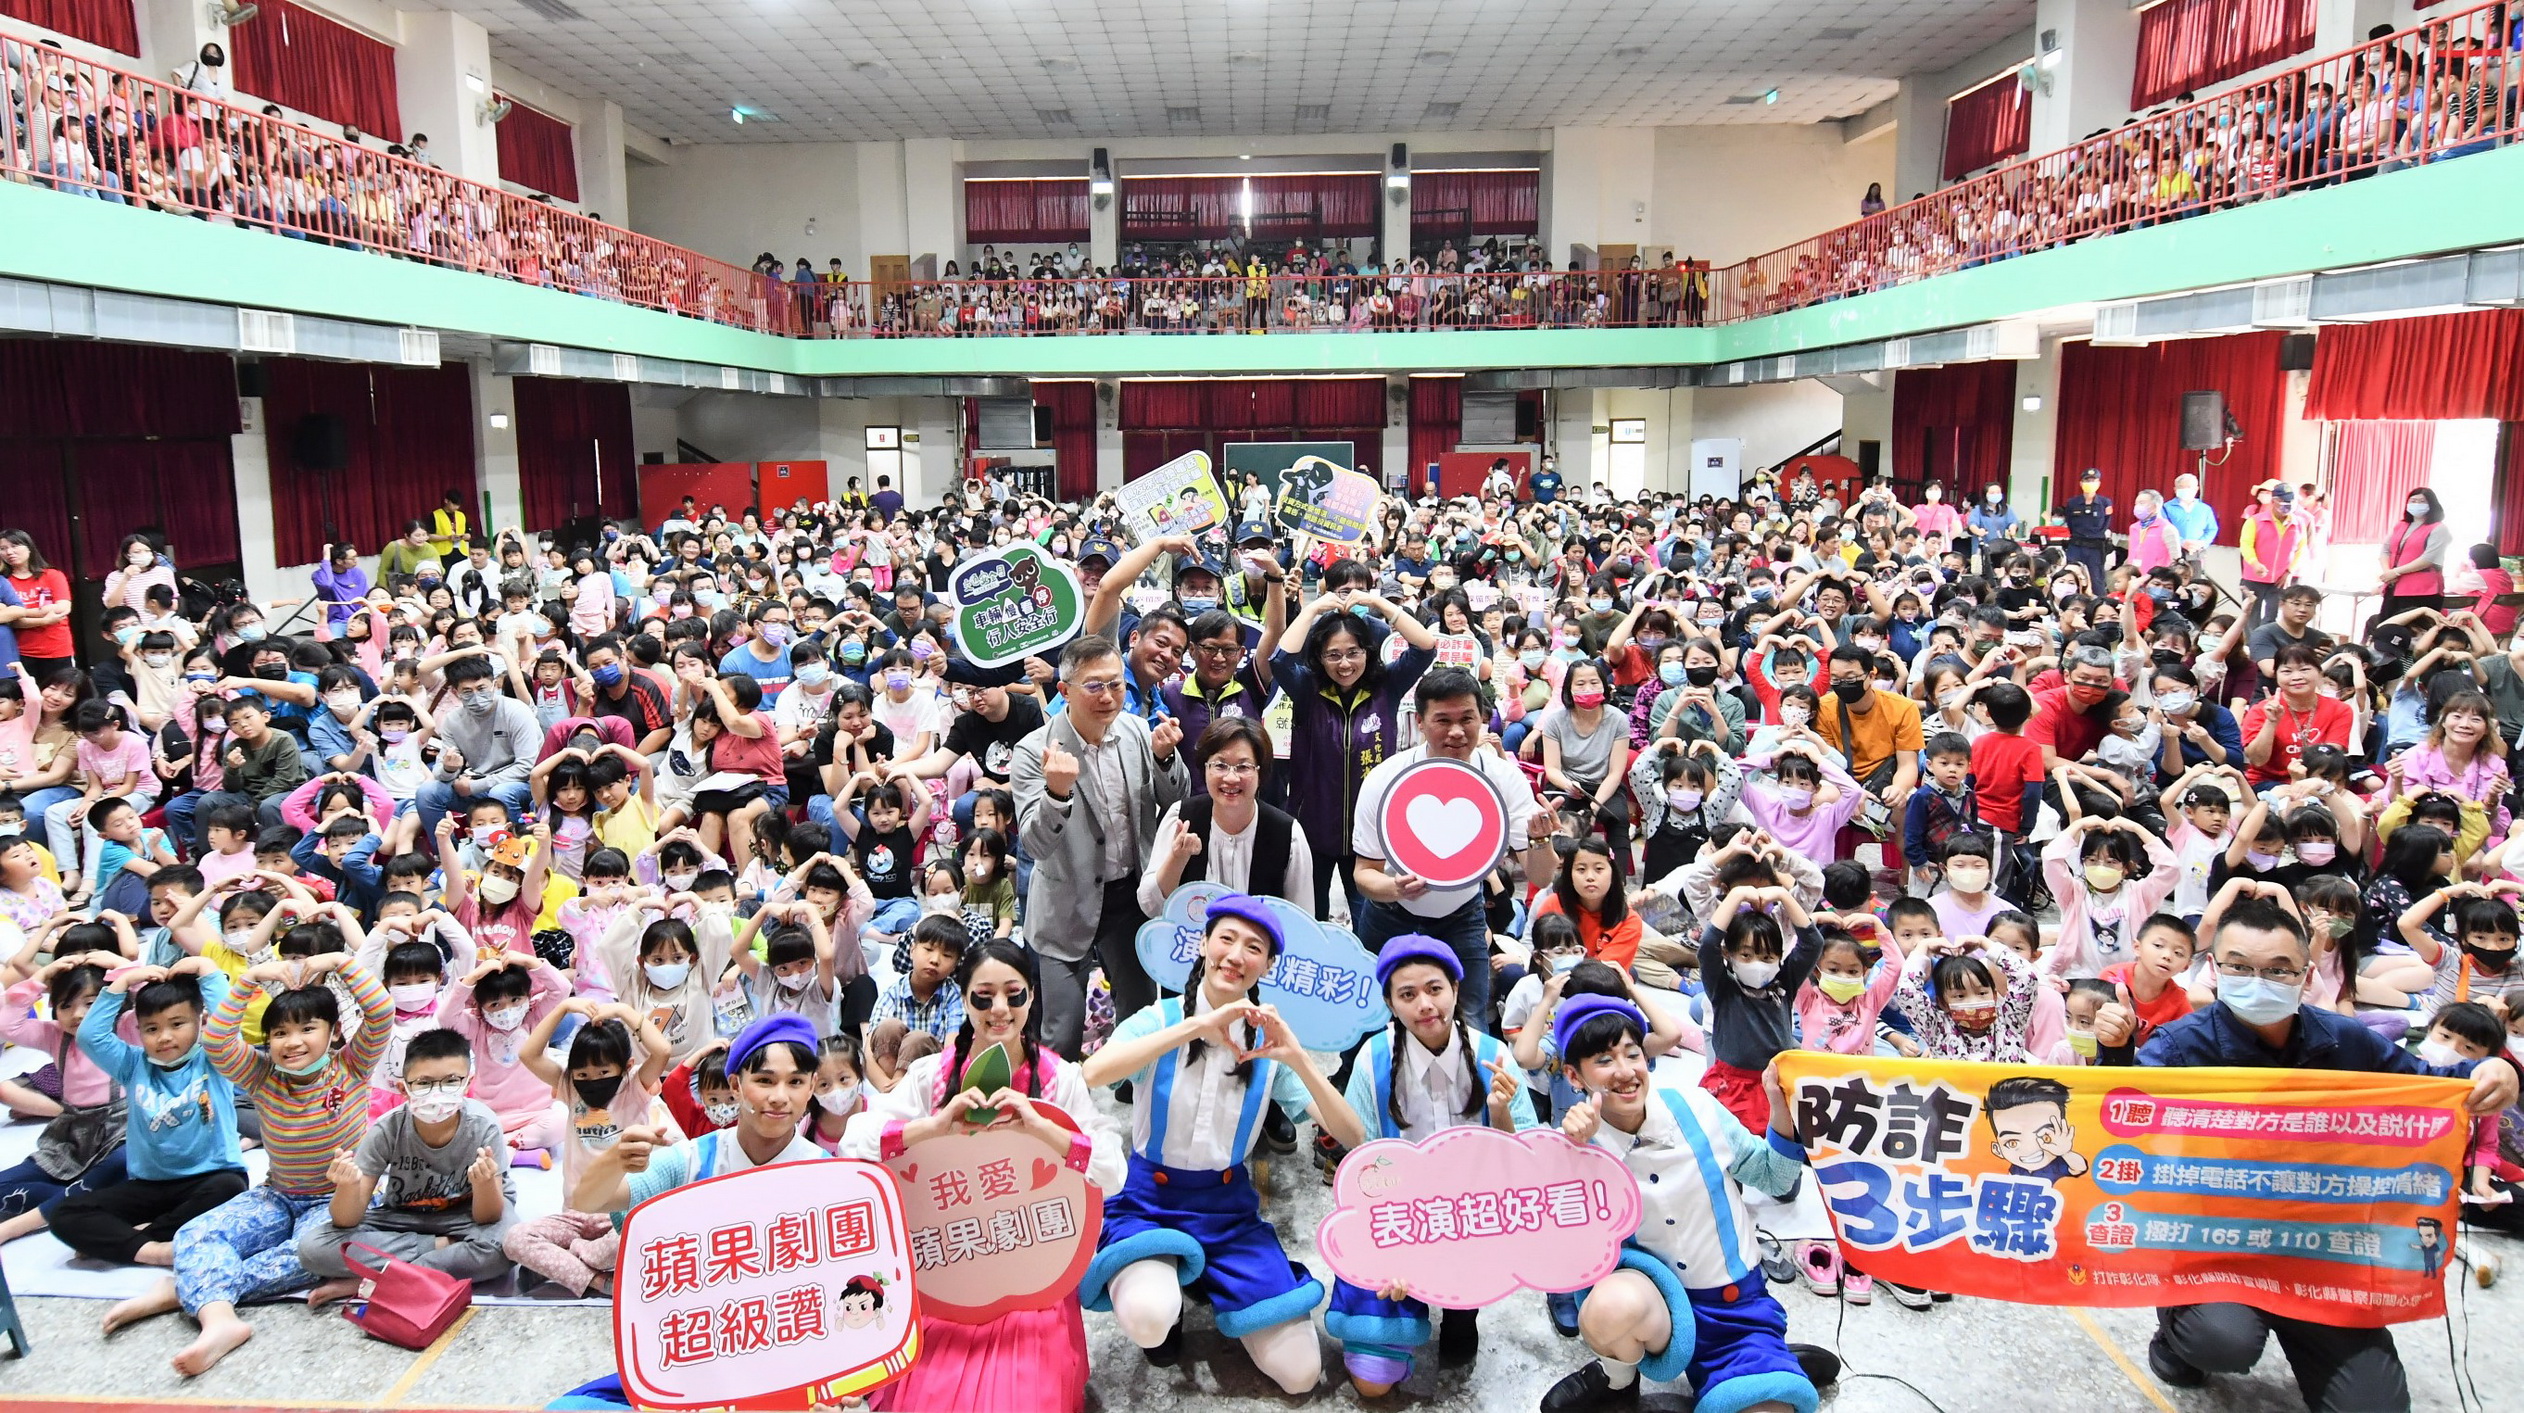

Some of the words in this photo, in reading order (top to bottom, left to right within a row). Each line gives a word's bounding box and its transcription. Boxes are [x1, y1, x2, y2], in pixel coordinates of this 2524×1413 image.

[985, 605, 1058, 649] 行人安全行
[1797, 1077, 1974, 1165] 防詐
[2109, 1101, 2154, 1126] 1聽
[929, 1157, 1020, 1211] 我愛
[2097, 1160, 2141, 1183] 2掛
[2152, 1163, 2442, 1198] 掛掉電話不讓對方操控情緒
[1370, 1180, 1612, 1249] 表演超好看！
[1815, 1160, 2057, 1256] 3步驟
[2105, 1203, 2121, 1223] 3
[642, 1200, 877, 1298] 蘋果劇團
[2087, 1223, 2137, 1247] 查證
[2144, 1219, 2193, 1243] 撥打
[2200, 1226, 2241, 1246] 165
[2247, 1227, 2272, 1249] 或
[2280, 1231, 2320, 1250] 110
[2327, 1230, 2383, 1259] 查證
[660, 1285, 828, 1370] 超級讚
